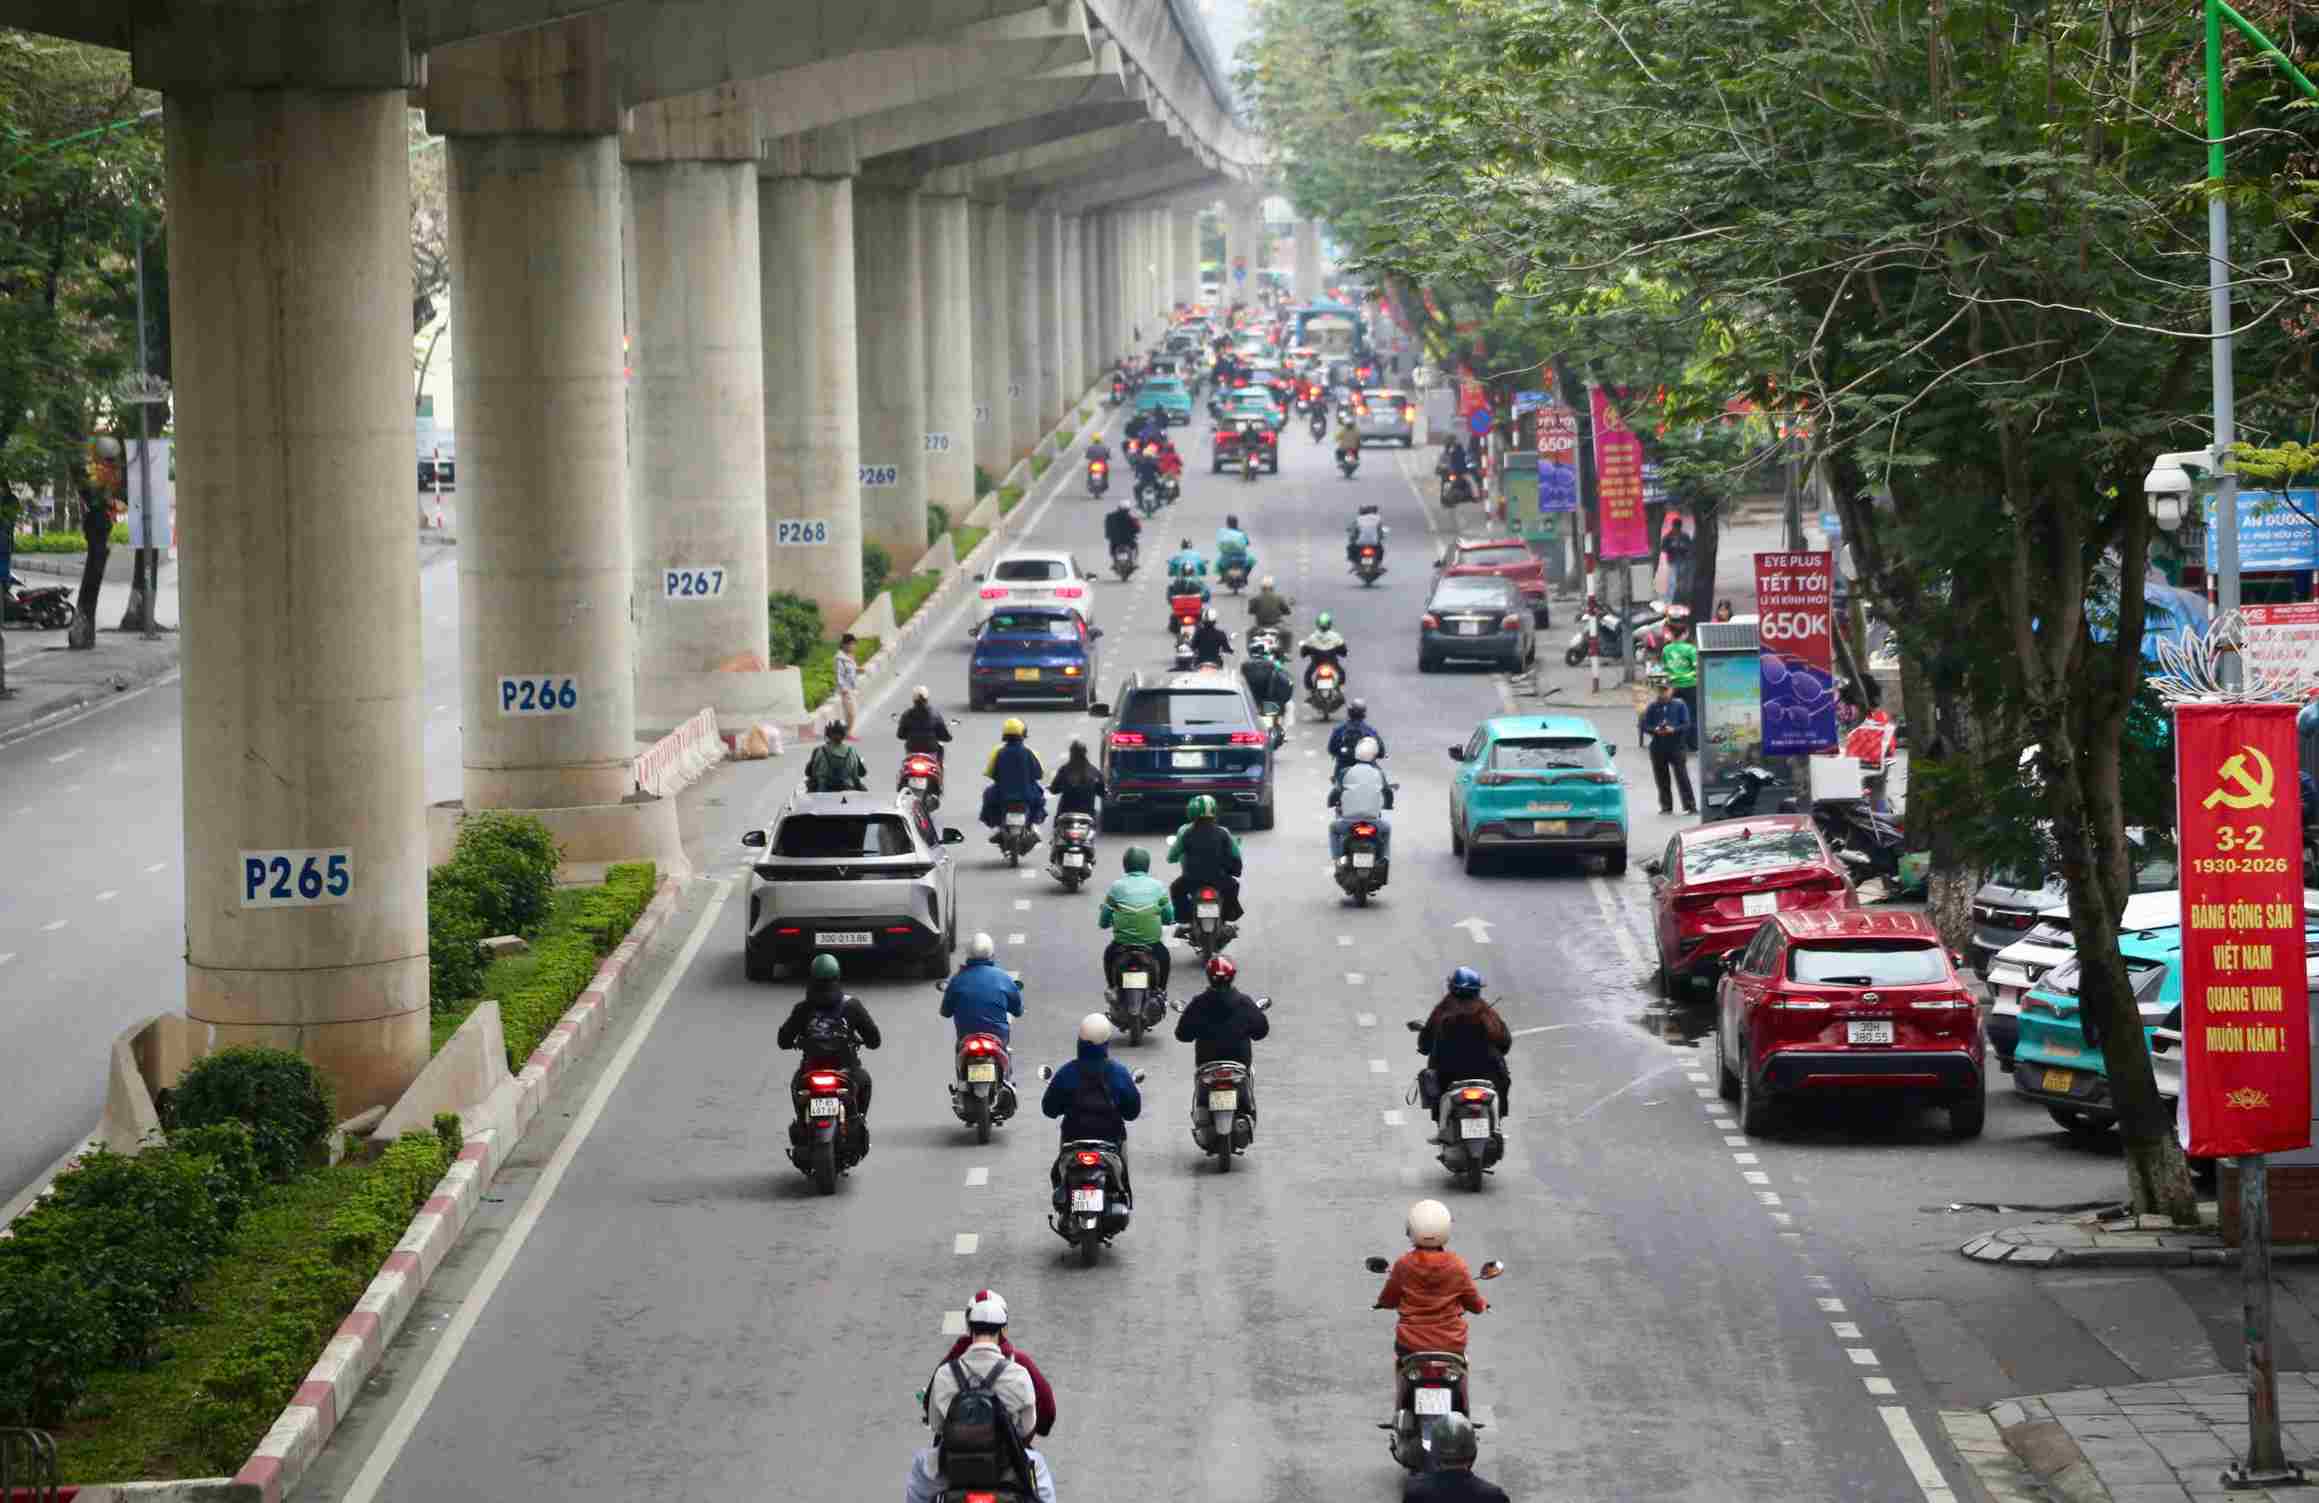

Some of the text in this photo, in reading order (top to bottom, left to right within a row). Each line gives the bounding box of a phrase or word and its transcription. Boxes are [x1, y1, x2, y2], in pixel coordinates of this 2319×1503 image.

[779, 522, 825, 543] P268
[1764, 555, 1822, 567] EYE PLUS
[667, 571, 723, 596] P267
[1760, 570, 1827, 592] TẾT TỚI
[1761, 612, 1826, 640] 650K
[503, 680, 577, 711] P266
[2216, 825, 2265, 851] 3-2
[246, 854, 350, 900] P265
[2192, 858, 2288, 874] 1930-2026
[2191, 892, 2293, 935] ĐẢNG CỘNG SẢN
[2213, 940, 2272, 976] VIỆT NAM
[2207, 986, 2282, 1013] QUANG VINH
[2206, 1022, 2244, 1052] MUÔN
[2247, 1022, 2277, 1052] NĂM
